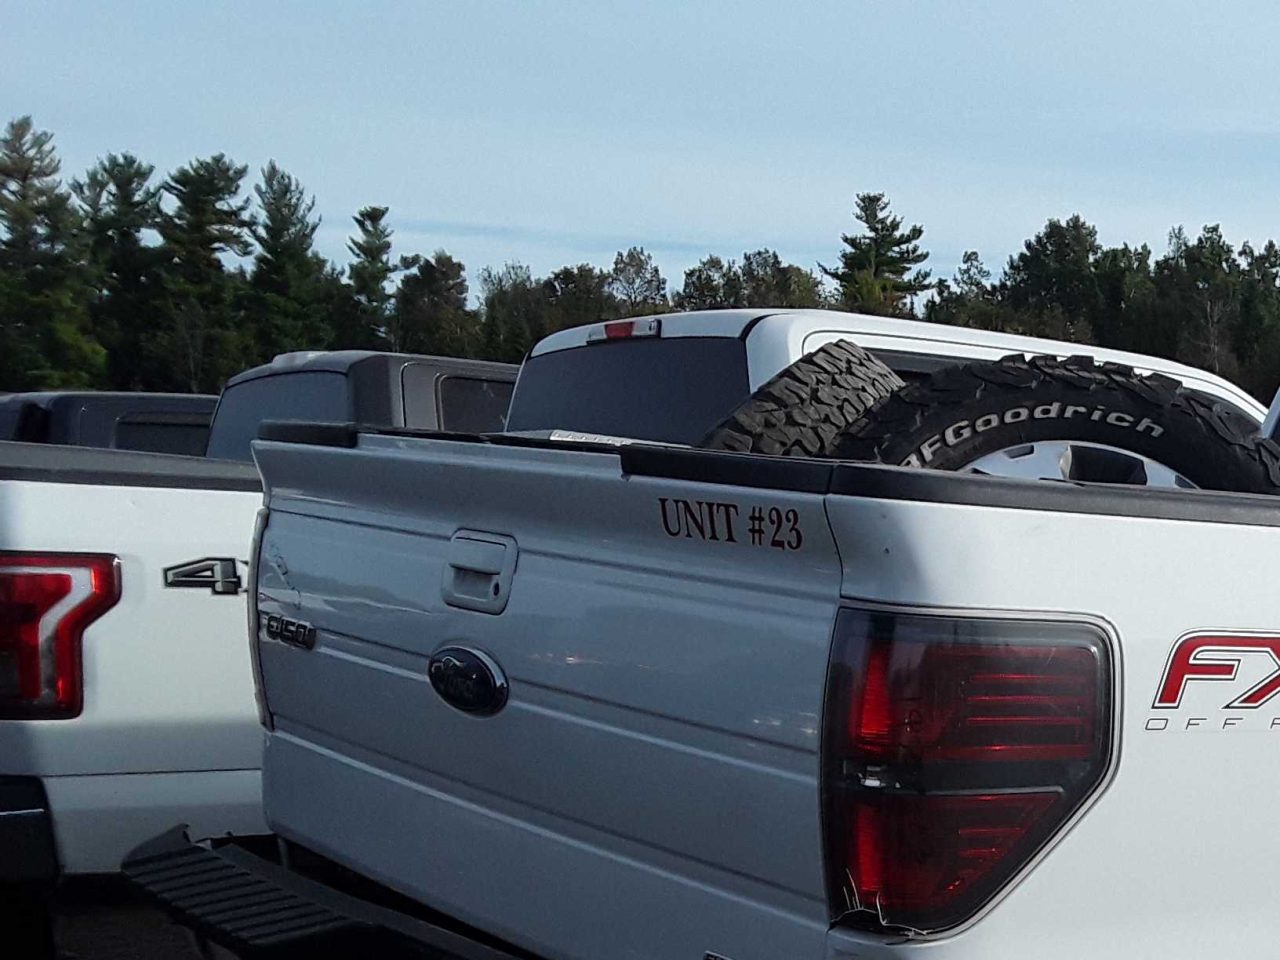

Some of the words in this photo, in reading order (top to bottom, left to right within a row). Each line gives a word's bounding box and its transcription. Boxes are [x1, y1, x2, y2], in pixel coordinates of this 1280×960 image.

[658, 498, 739, 543] UNIT
[748, 506, 802, 550] #23
[1144, 717, 1244, 731] OFF
